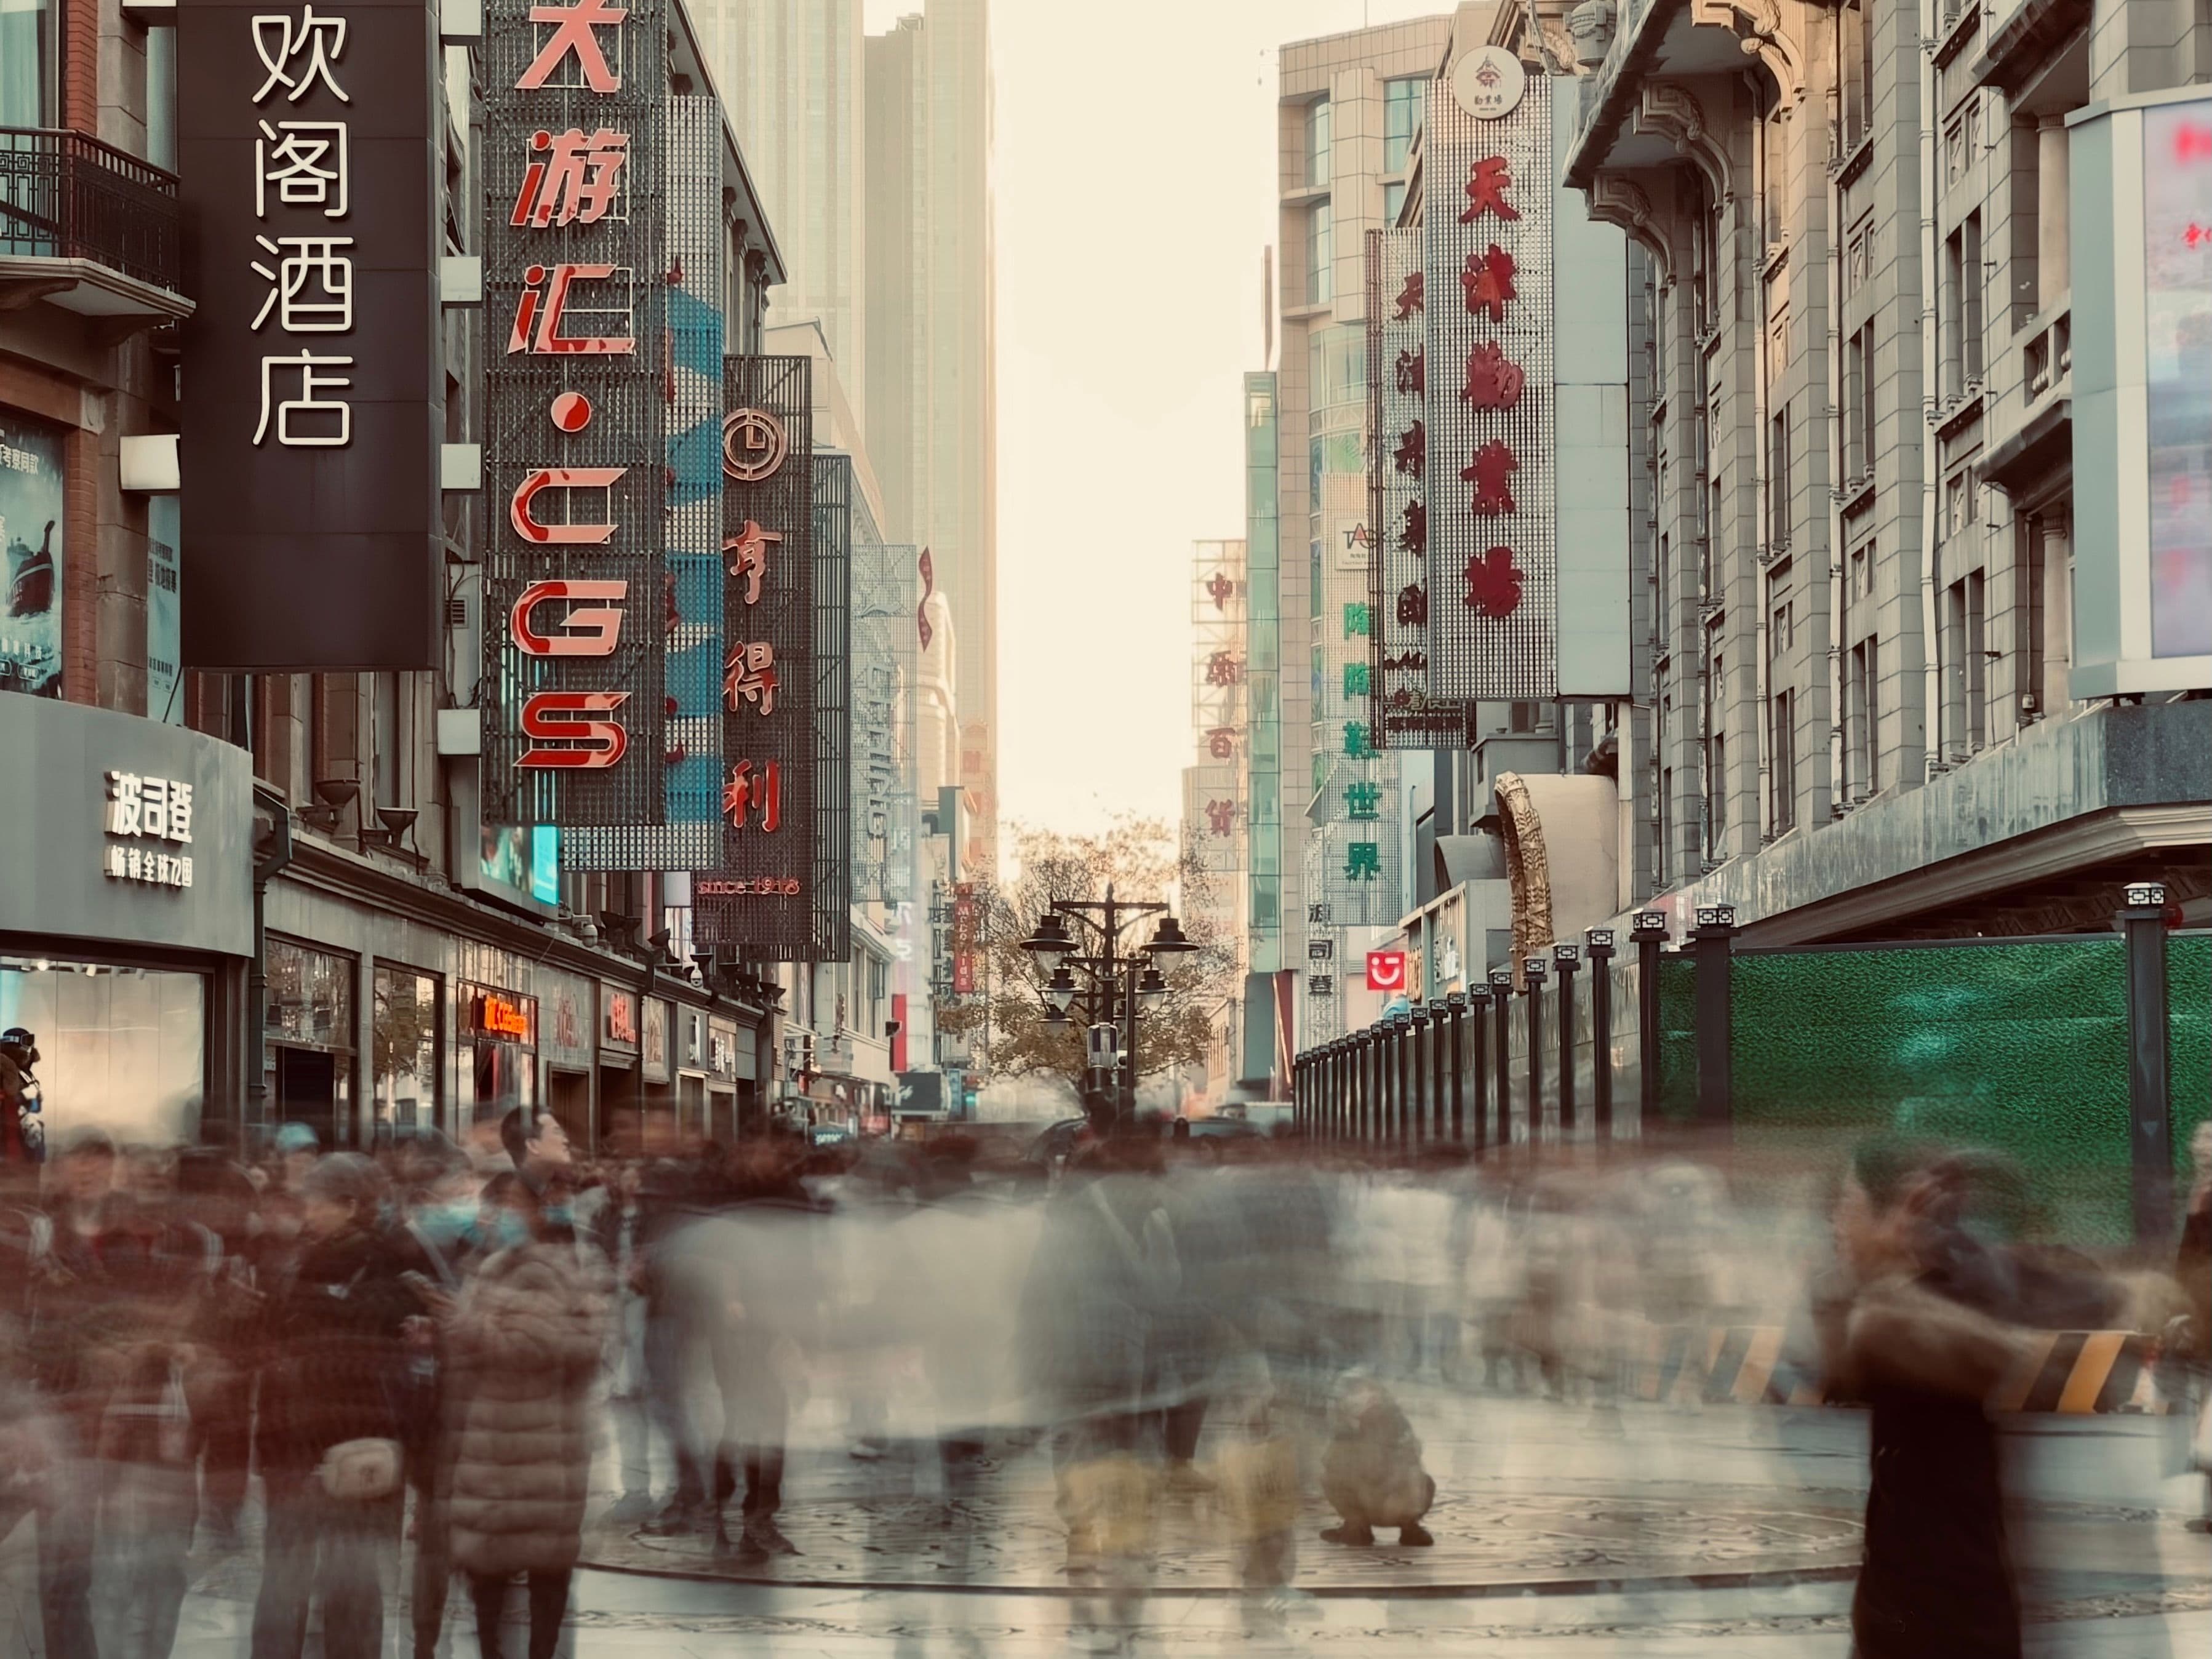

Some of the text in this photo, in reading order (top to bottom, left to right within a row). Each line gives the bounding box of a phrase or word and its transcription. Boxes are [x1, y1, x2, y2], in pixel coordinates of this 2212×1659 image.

[250, 4, 355, 446] 欢阁酒店
[111, 770, 193, 843] 波司登
[111, 845, 193, 887] 畅销全球72国
[697, 881, 746, 895] since
